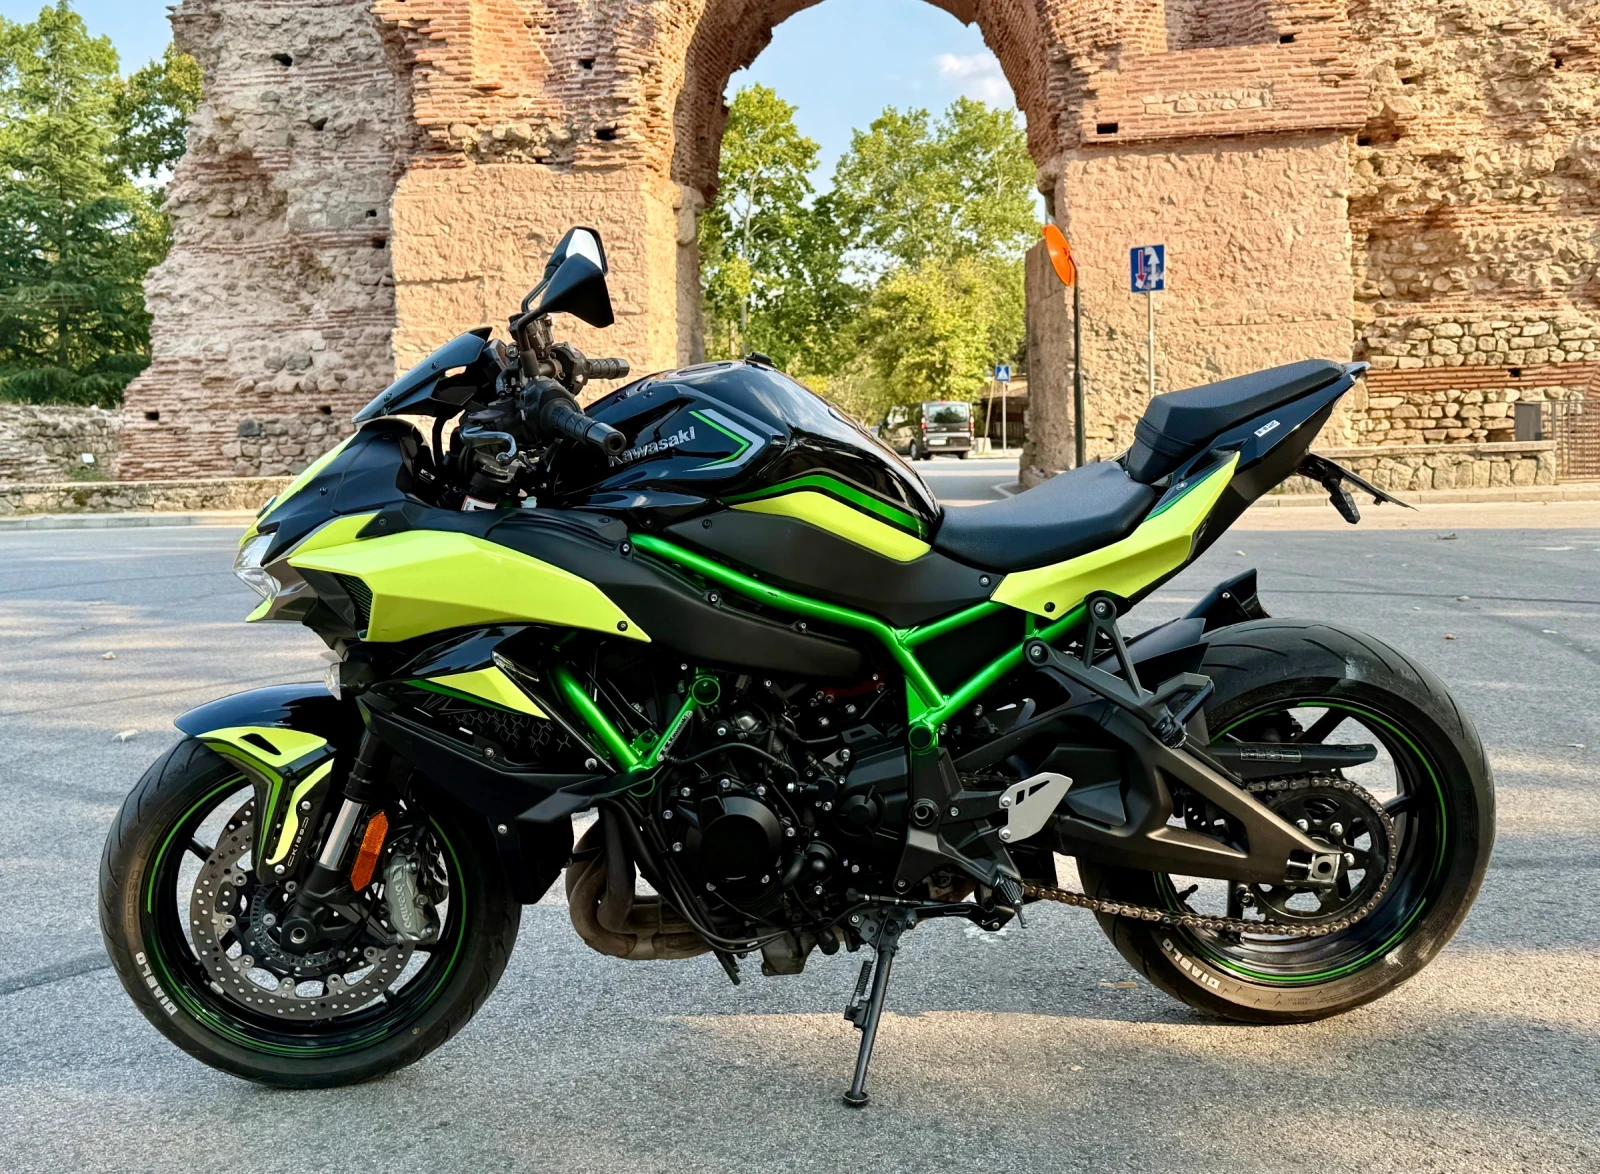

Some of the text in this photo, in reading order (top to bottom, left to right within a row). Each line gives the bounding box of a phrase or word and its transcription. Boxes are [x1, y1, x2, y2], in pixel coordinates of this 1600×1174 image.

[608, 425, 696, 467] Kawasaki
[394, 884, 413, 929] brembo
[135, 951, 178, 1016] DIABLO
[1162, 938, 1221, 990] DIABLO
